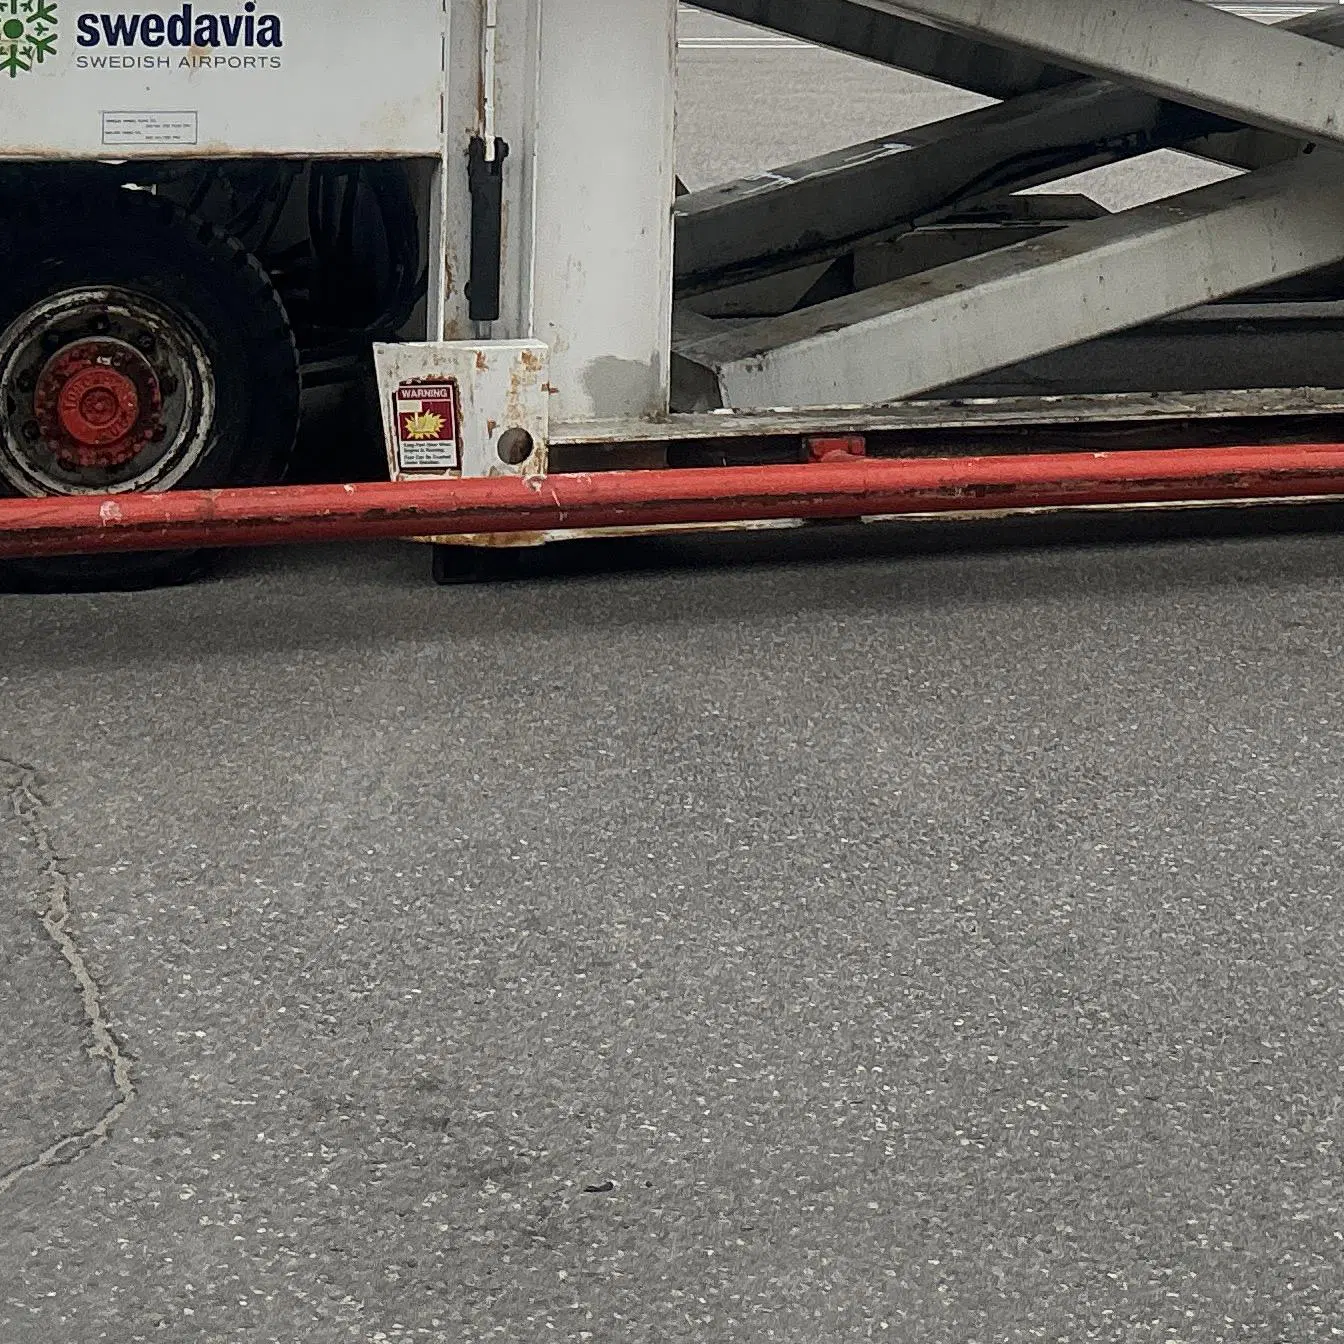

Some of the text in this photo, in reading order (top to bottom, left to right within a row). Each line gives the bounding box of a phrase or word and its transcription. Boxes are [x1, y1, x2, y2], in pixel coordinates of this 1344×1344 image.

[76, 1, 283, 47] swedavia
[76, 56, 282, 69] SWEDISH AIRPORTS
[401, 388, 448, 398] WARNING
